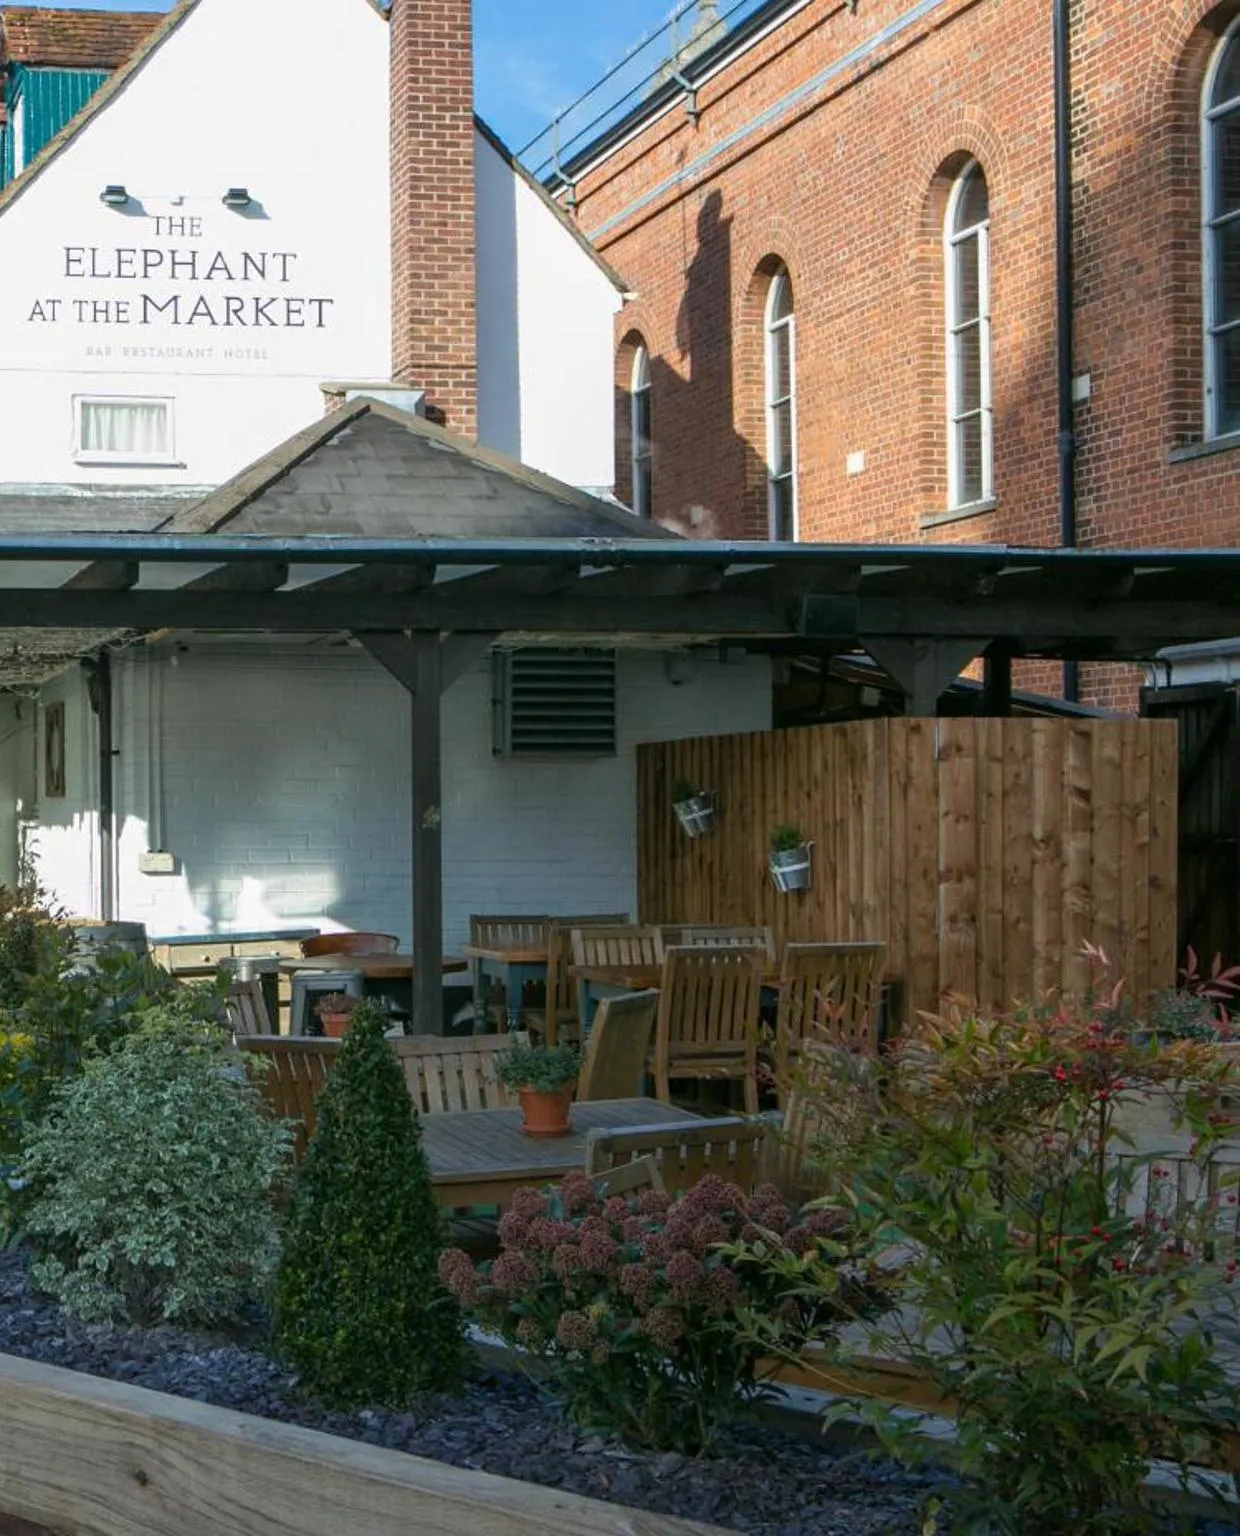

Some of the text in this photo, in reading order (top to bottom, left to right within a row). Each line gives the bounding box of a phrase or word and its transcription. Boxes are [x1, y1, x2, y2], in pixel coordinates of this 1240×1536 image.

[152, 215, 203, 238] THE
[64, 246, 298, 283] ELEPHANT
[28, 293, 334, 328] AT THE MARKET
